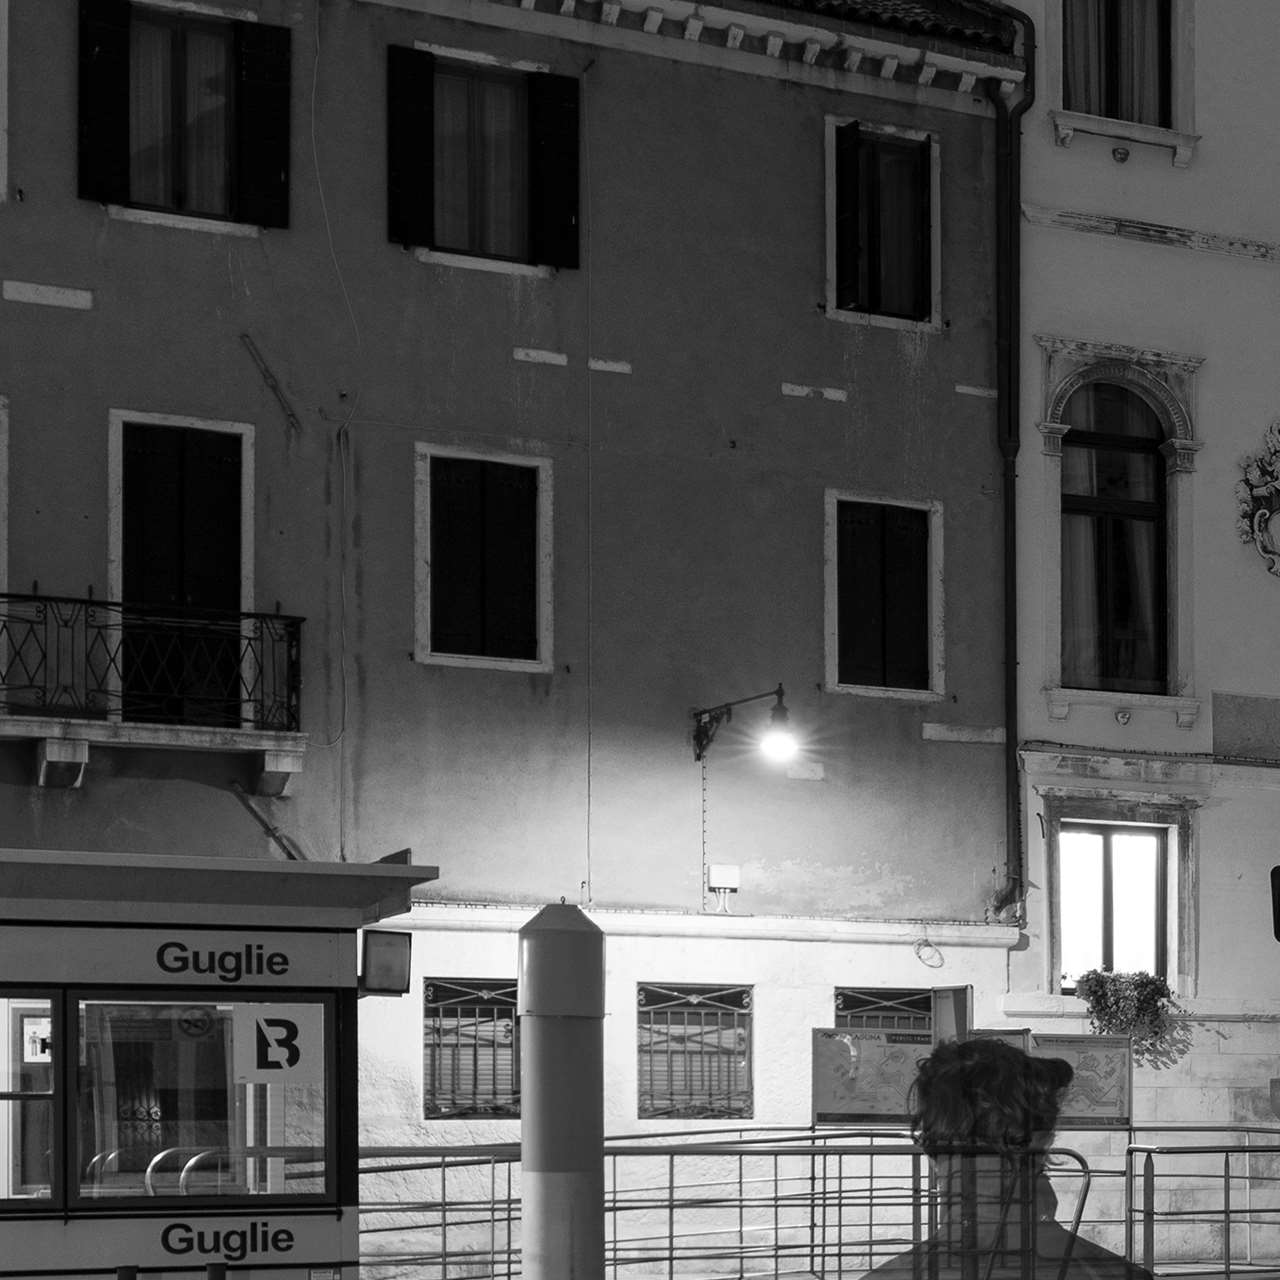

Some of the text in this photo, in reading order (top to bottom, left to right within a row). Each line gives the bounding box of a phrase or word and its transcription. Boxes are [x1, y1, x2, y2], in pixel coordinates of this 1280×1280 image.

[156, 941, 289, 983] Guglie
[256, 1018, 300, 1070] B
[160, 1221, 294, 1261] Guglie
